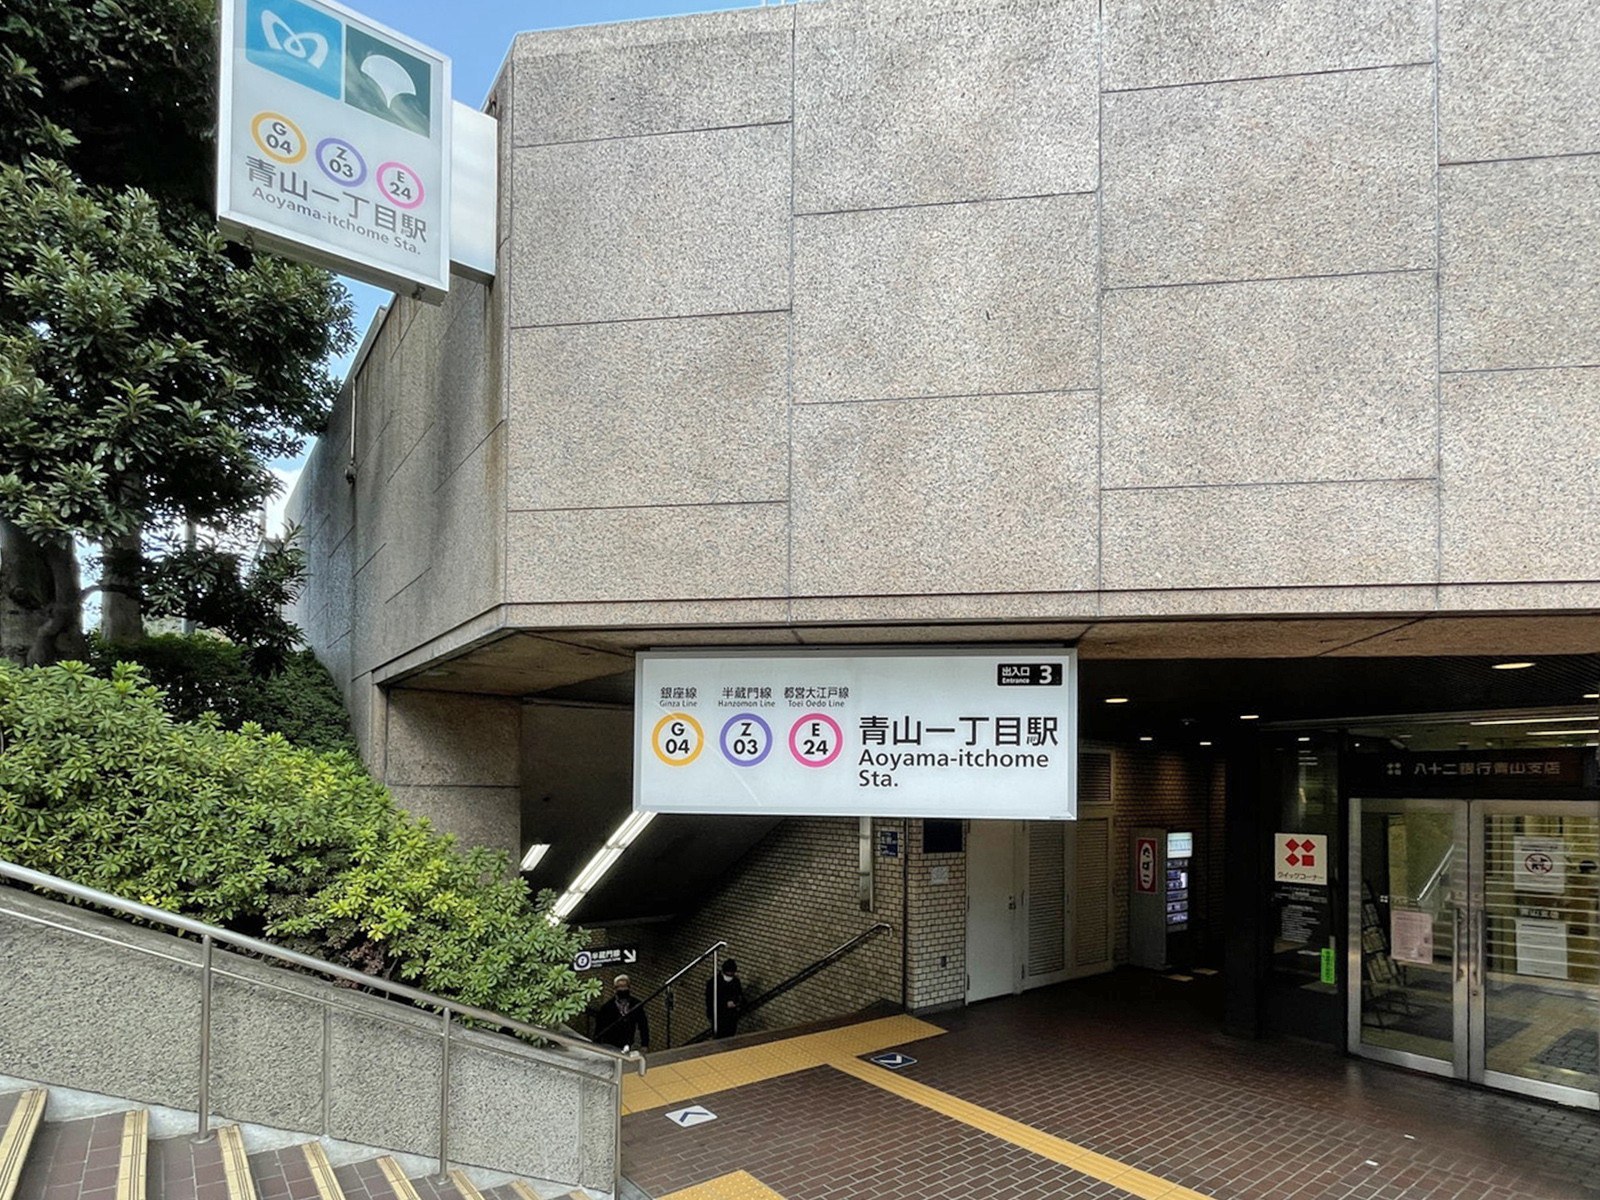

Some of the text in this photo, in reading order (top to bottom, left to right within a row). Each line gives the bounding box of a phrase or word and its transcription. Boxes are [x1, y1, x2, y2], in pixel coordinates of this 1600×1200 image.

[272, 122, 286, 136] G
[266, 134, 292, 154] 04
[335, 147, 349, 161] Z
[329, 159, 354, 178] 03
[397, 171, 405, 184] E
[245, 155, 427, 243] 青山一丁目駅
[389, 183, 412, 200] 24
[252, 187, 421, 255] Aoyama-itchome Sta.
[1002, 665, 1052, 684] 出入口 3
[660, 687, 698, 699] 銀座線
[722, 687, 772, 699] 半蔵門線
[784, 686, 849, 699] 都営大江戸線
[659, 700, 698, 708] Ginza Line
[718, 700, 776, 708] Hanzomon Line
[788, 700, 845, 708] Toei Oedo Line
[671, 722, 685, 737] G
[741, 723, 752, 737] Z
[812, 723, 820, 737] E
[859, 715, 1058, 747] 青山一丁目駅
[665, 739, 690, 754] 04
[733, 739, 758, 755] 03
[803, 740, 829, 755] 24
[858, 749, 1049, 771] Aoyama-itchome
[859, 769, 899, 787] Sta.
